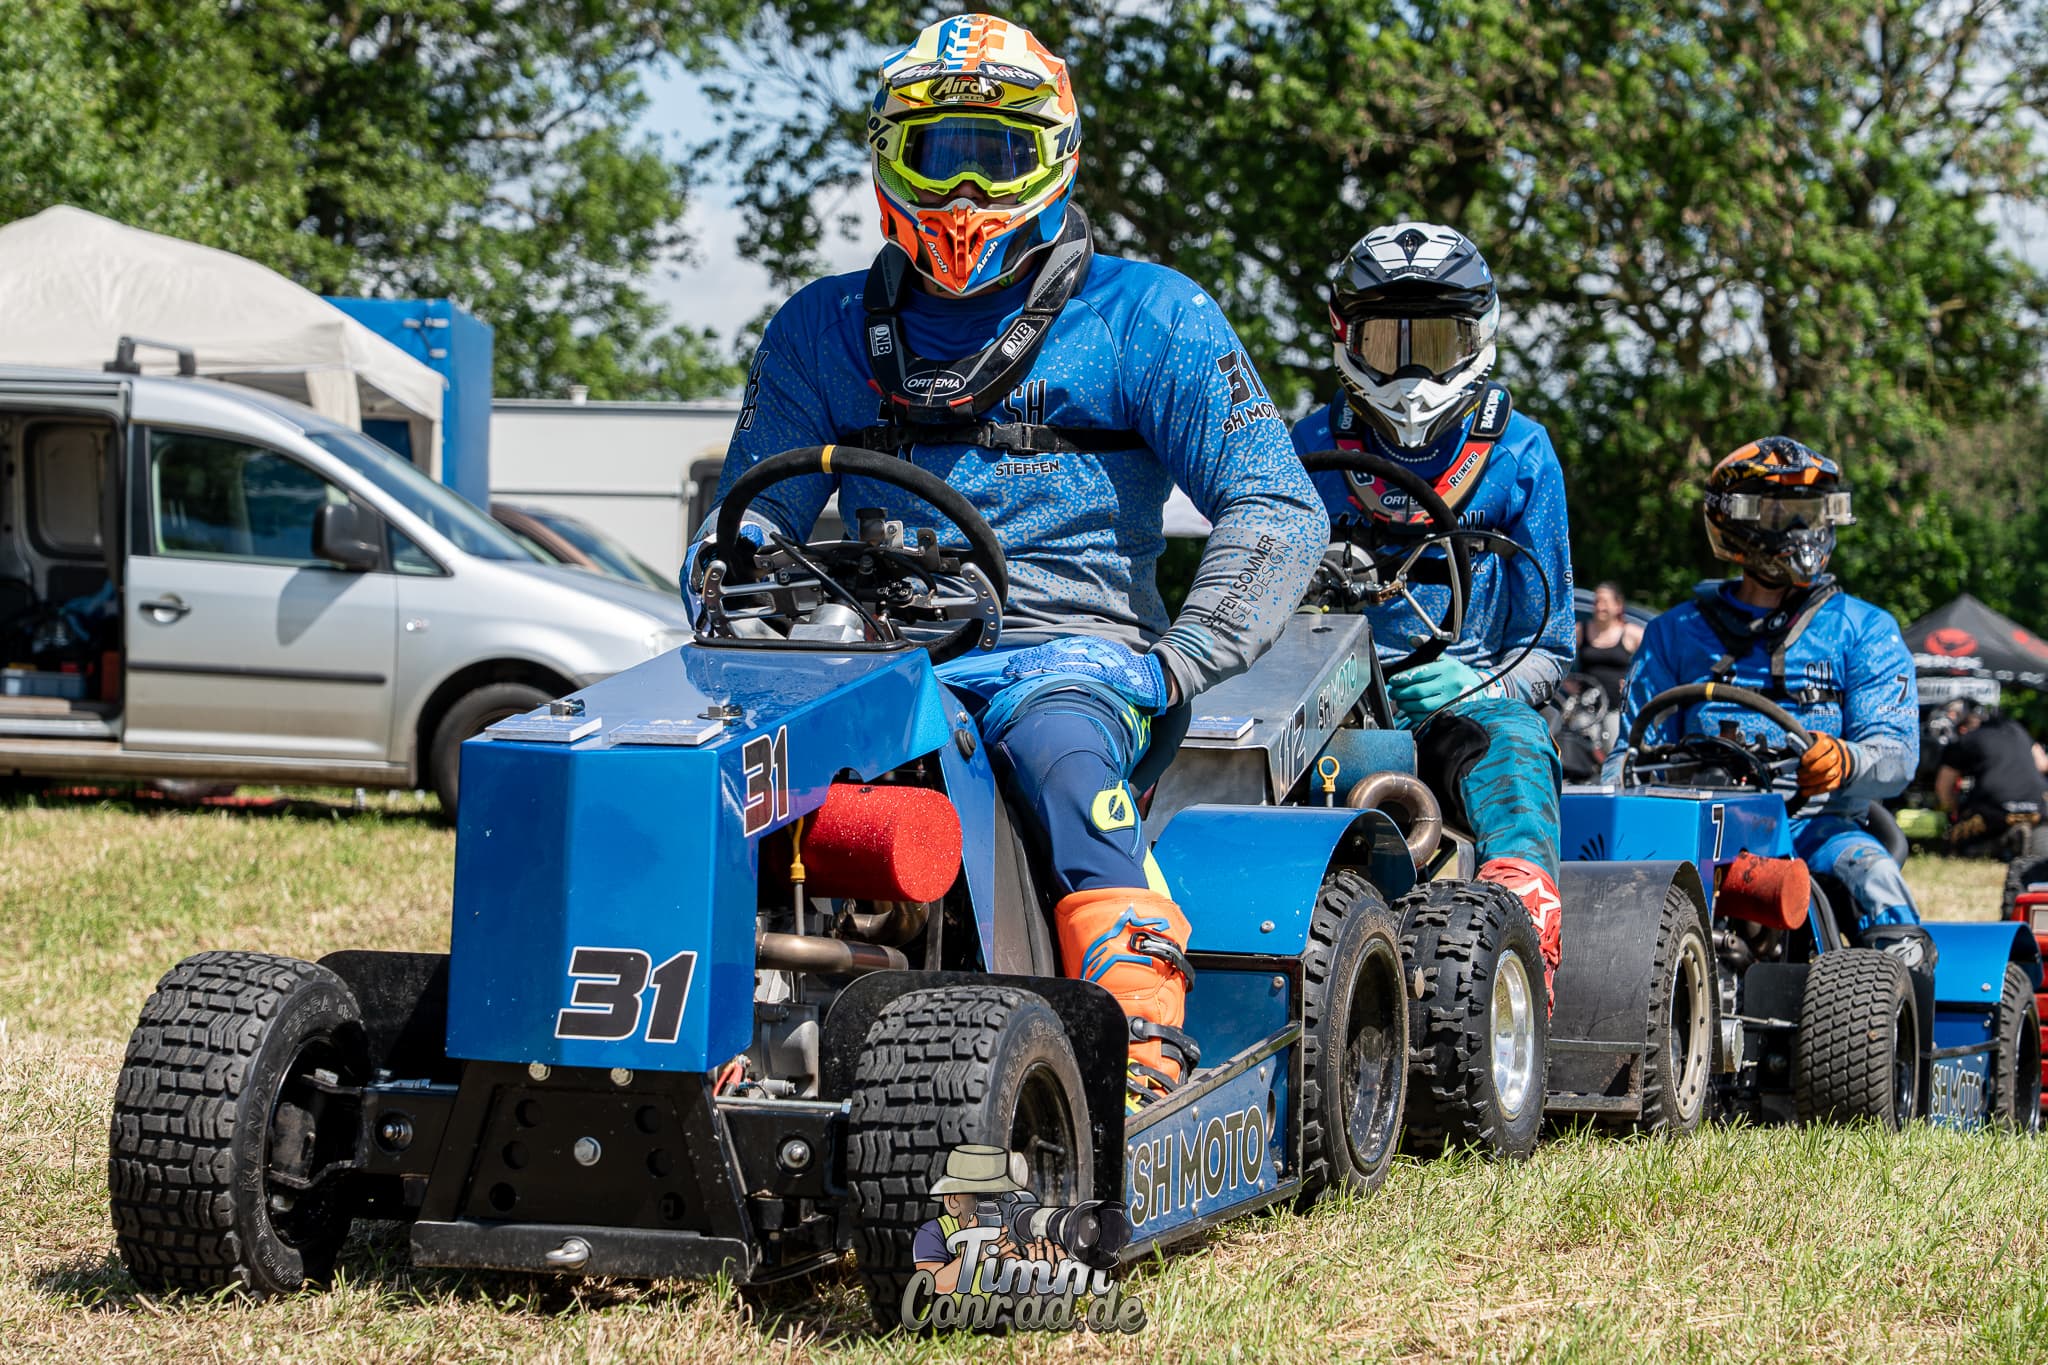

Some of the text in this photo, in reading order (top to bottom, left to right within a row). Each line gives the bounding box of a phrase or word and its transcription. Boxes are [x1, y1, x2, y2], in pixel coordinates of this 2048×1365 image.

[933, 76, 997, 97] Airoh
[927, 241, 948, 273] Airoh
[976, 241, 998, 274] Airoh
[1034, 277, 1052, 298] OTEMA
[907, 378, 960, 389] ORTEMA
[1216, 350, 1265, 407] 31
[1003, 379, 1046, 425] SH
[1222, 402, 1282, 436] SH MOT
[995, 460, 1060, 476] STEFFEN
[1449, 452, 1479, 487] REINERS
[1233, 534, 1276, 592] SOMMER
[1896, 674, 1909, 704] 7
[743, 724, 790, 837] 31
[1711, 804, 1726, 862] 7
[554, 946, 698, 1044] 31
[1932, 1064, 1949, 1117] SH
[1130, 1104, 1265, 1228] SH MOTO
